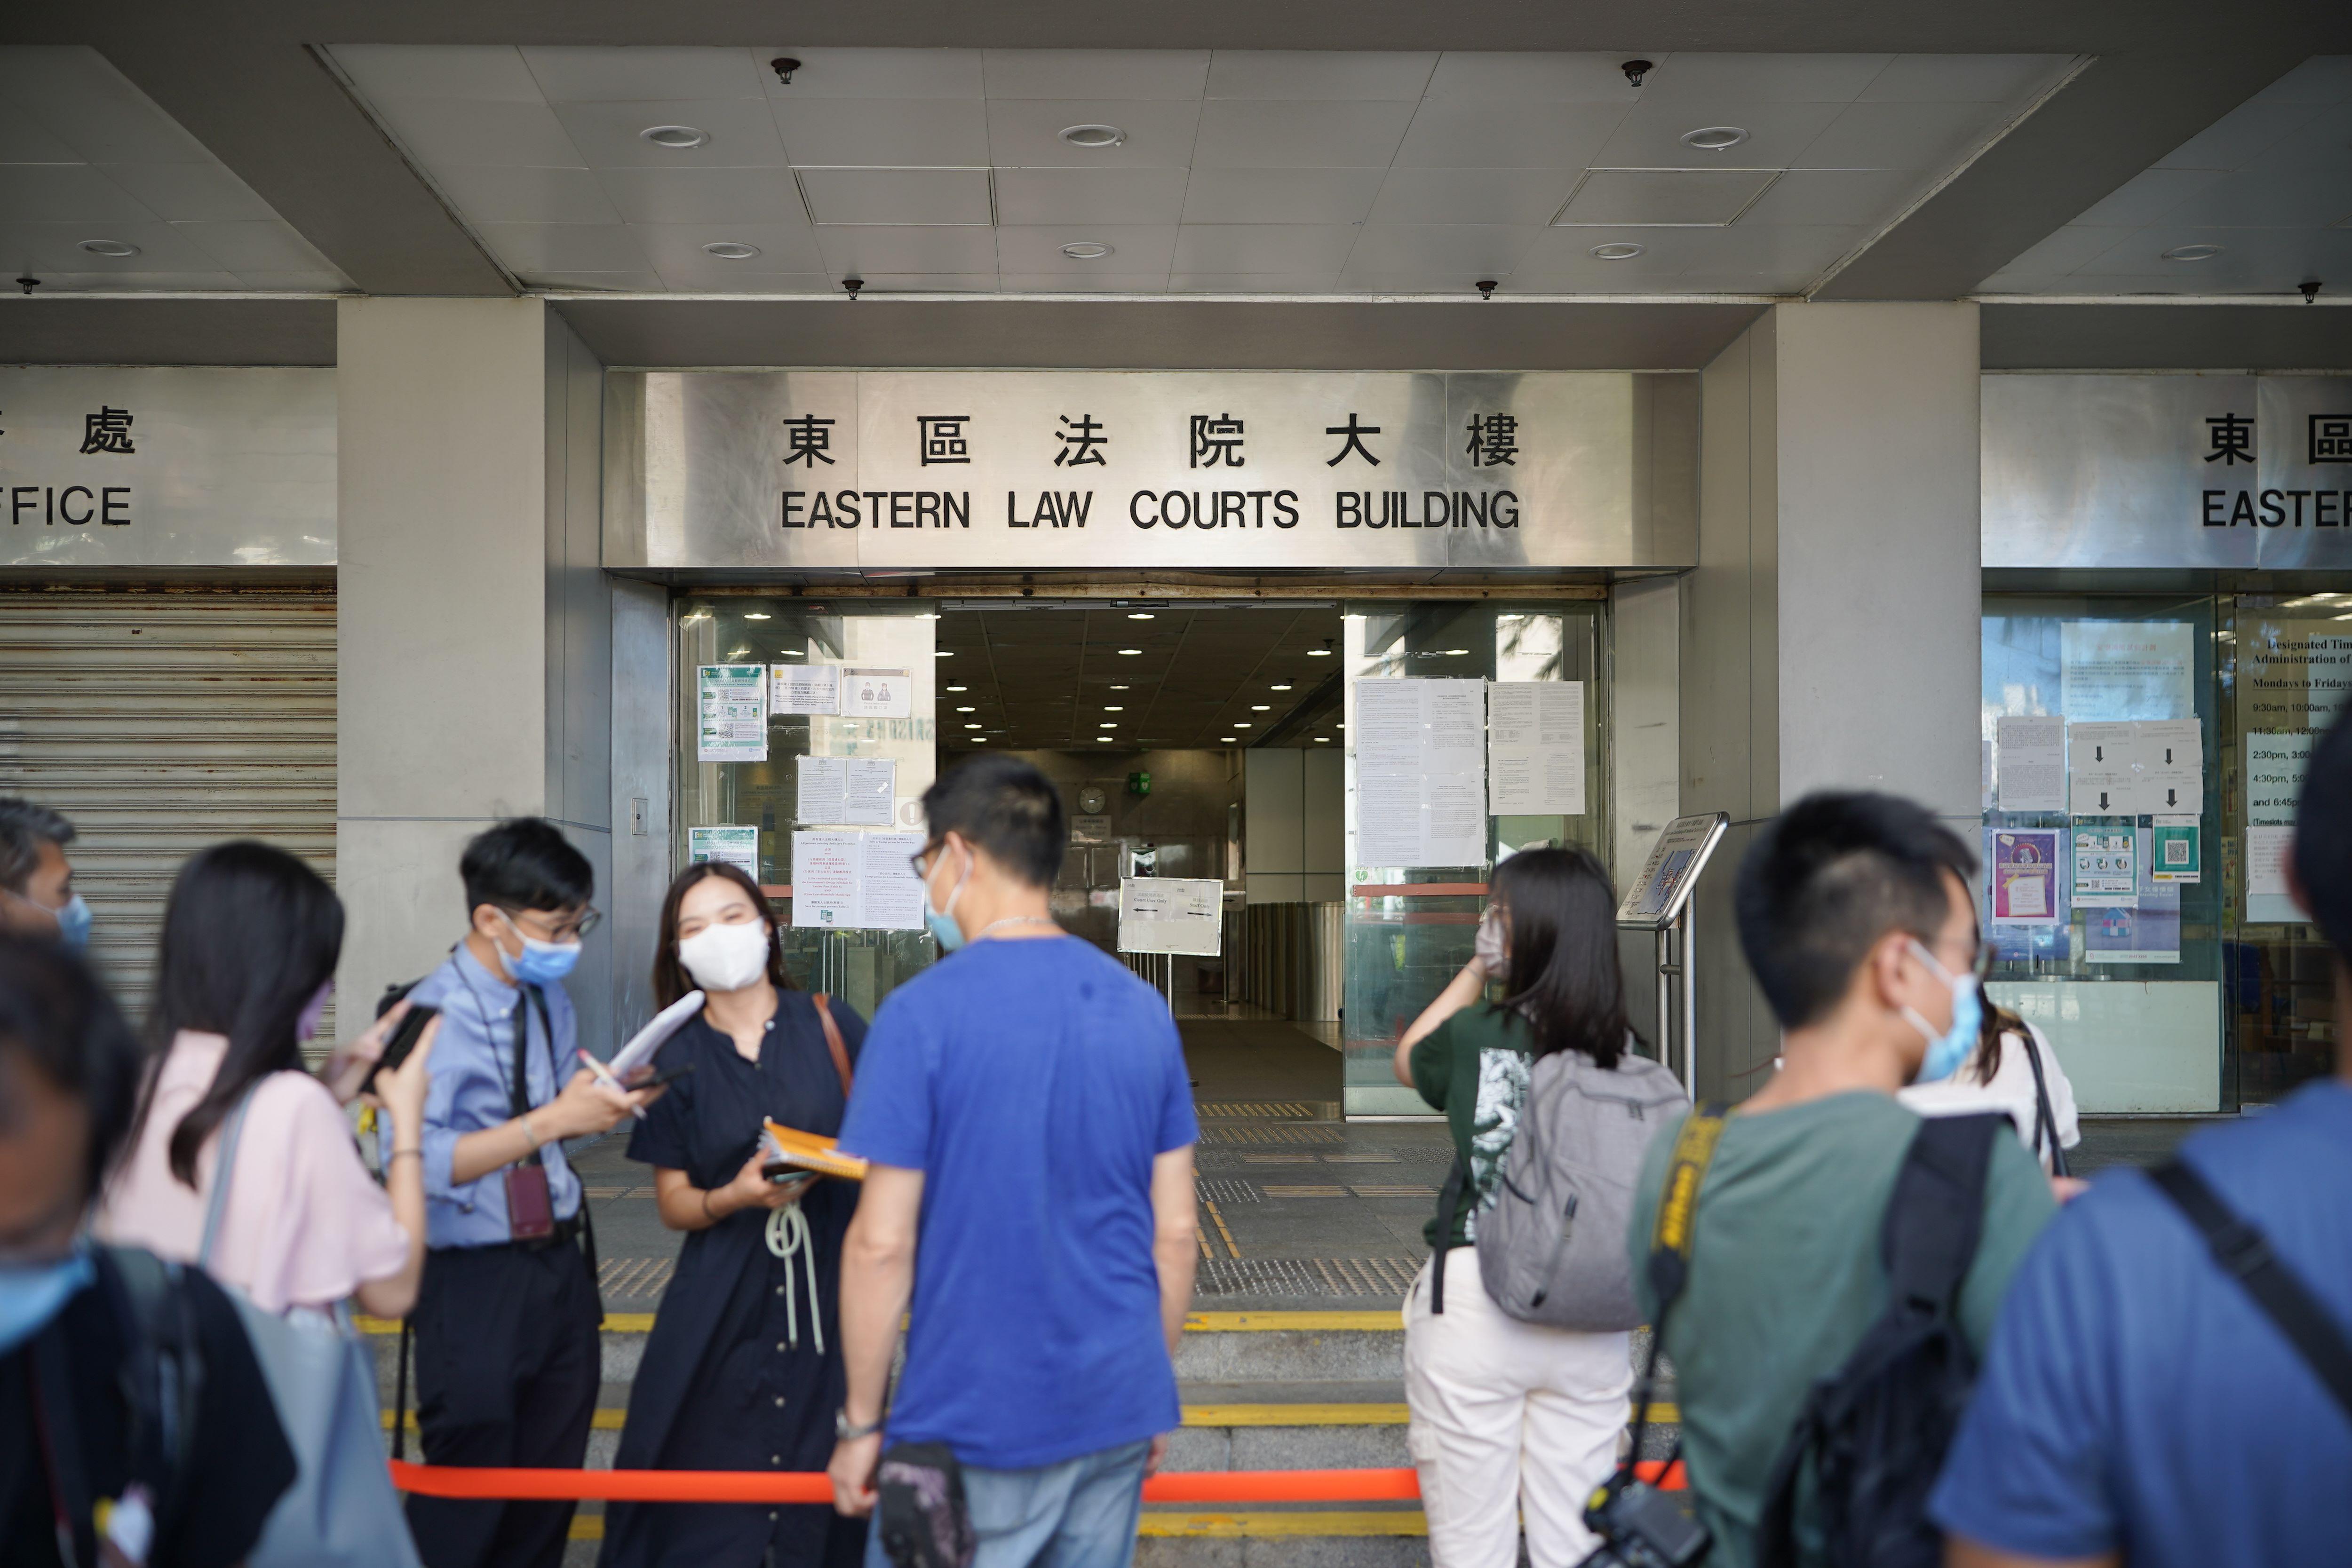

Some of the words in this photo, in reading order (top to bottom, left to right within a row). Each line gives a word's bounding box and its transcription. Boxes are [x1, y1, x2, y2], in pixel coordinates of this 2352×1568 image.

[783, 413, 1519, 468] 東區法院大樓
[2204, 413, 2352, 464] 東區
[0, 486, 131, 525] FICE
[782, 490, 969, 529] EASTERN
[1009, 491, 1093, 528] LAW
[1130, 490, 1299, 529] COURTS
[1337, 491, 1519, 529] BUILDING
[2268, 639, 2327, 651] Designated
[2252, 654, 2336, 664] Administration
[2340, 654, 2352, 664] of
[2253, 679, 2298, 690] Mondays
[2315, 679, 2352, 690] Fridays
[2253, 704, 2288, 713] 9:30am,
[2292, 704, 2330, 713] 10:00am,
[2253, 727, 2293, 736] 11:30am,
[2253, 751, 2288, 761] 2:30pm,
[2253, 774, 2288, 784] 4:30pm,
[2253, 798, 2270, 807] and
[2273, 798, 2298, 808] 6:45p
[2253, 818, 2283, 826] (Timeslots
